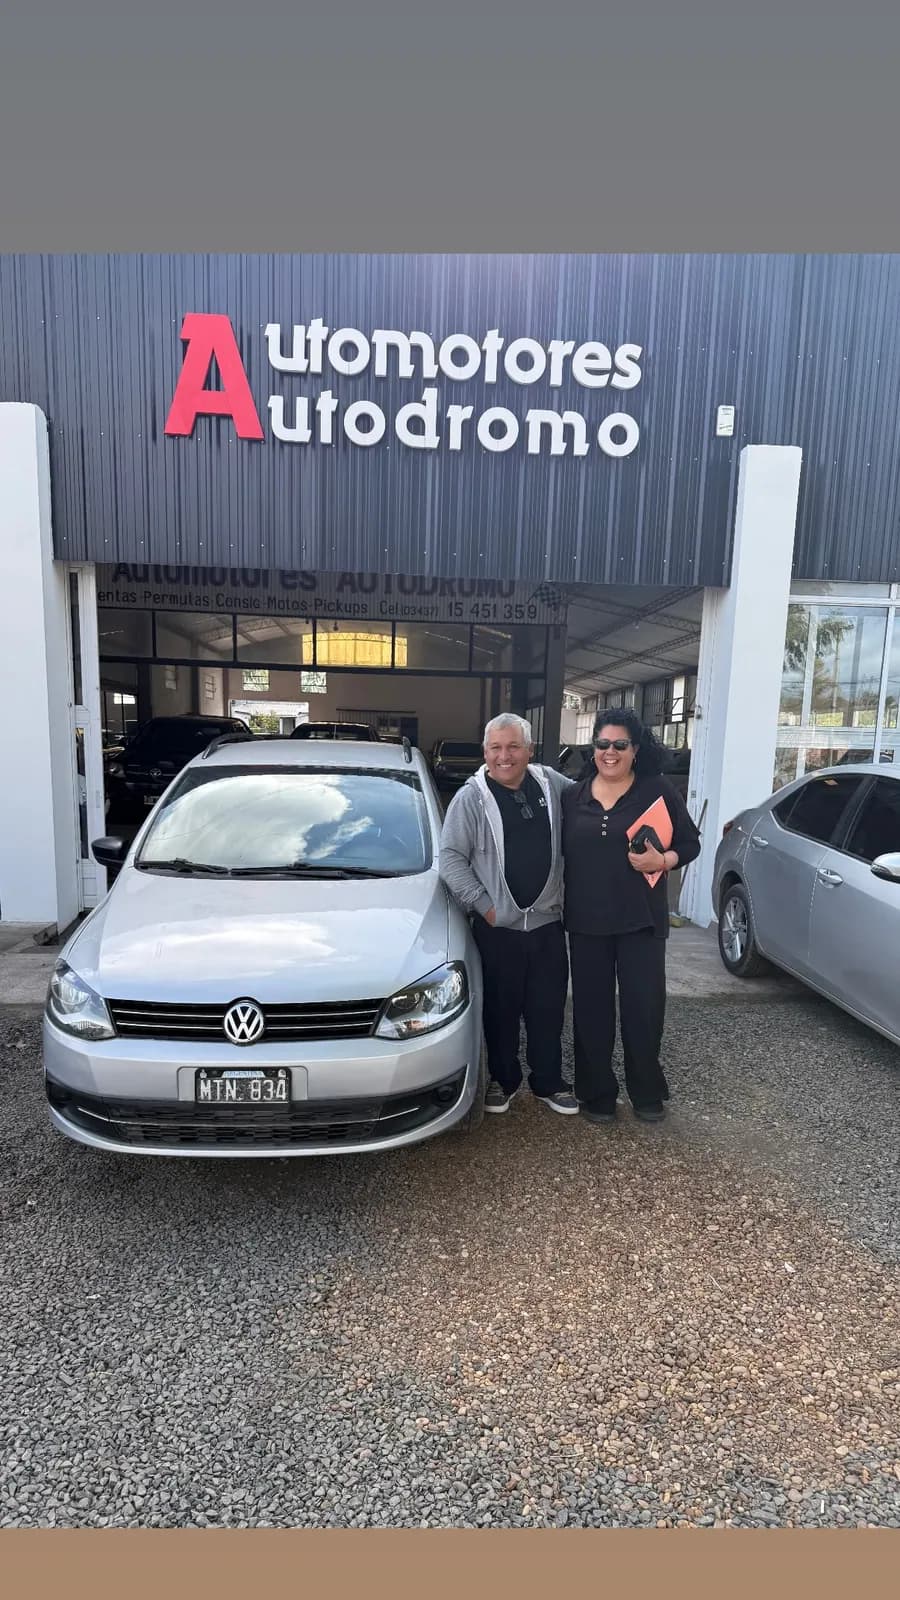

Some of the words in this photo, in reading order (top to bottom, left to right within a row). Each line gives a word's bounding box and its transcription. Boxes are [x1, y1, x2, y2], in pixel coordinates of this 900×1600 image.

[448, 601, 464, 617] 15
[469, 602, 497, 619] 451
[503, 603, 537, 620] 359
[200, 1079, 237, 1101] MTN
[249, 1079, 287, 1101] 834
